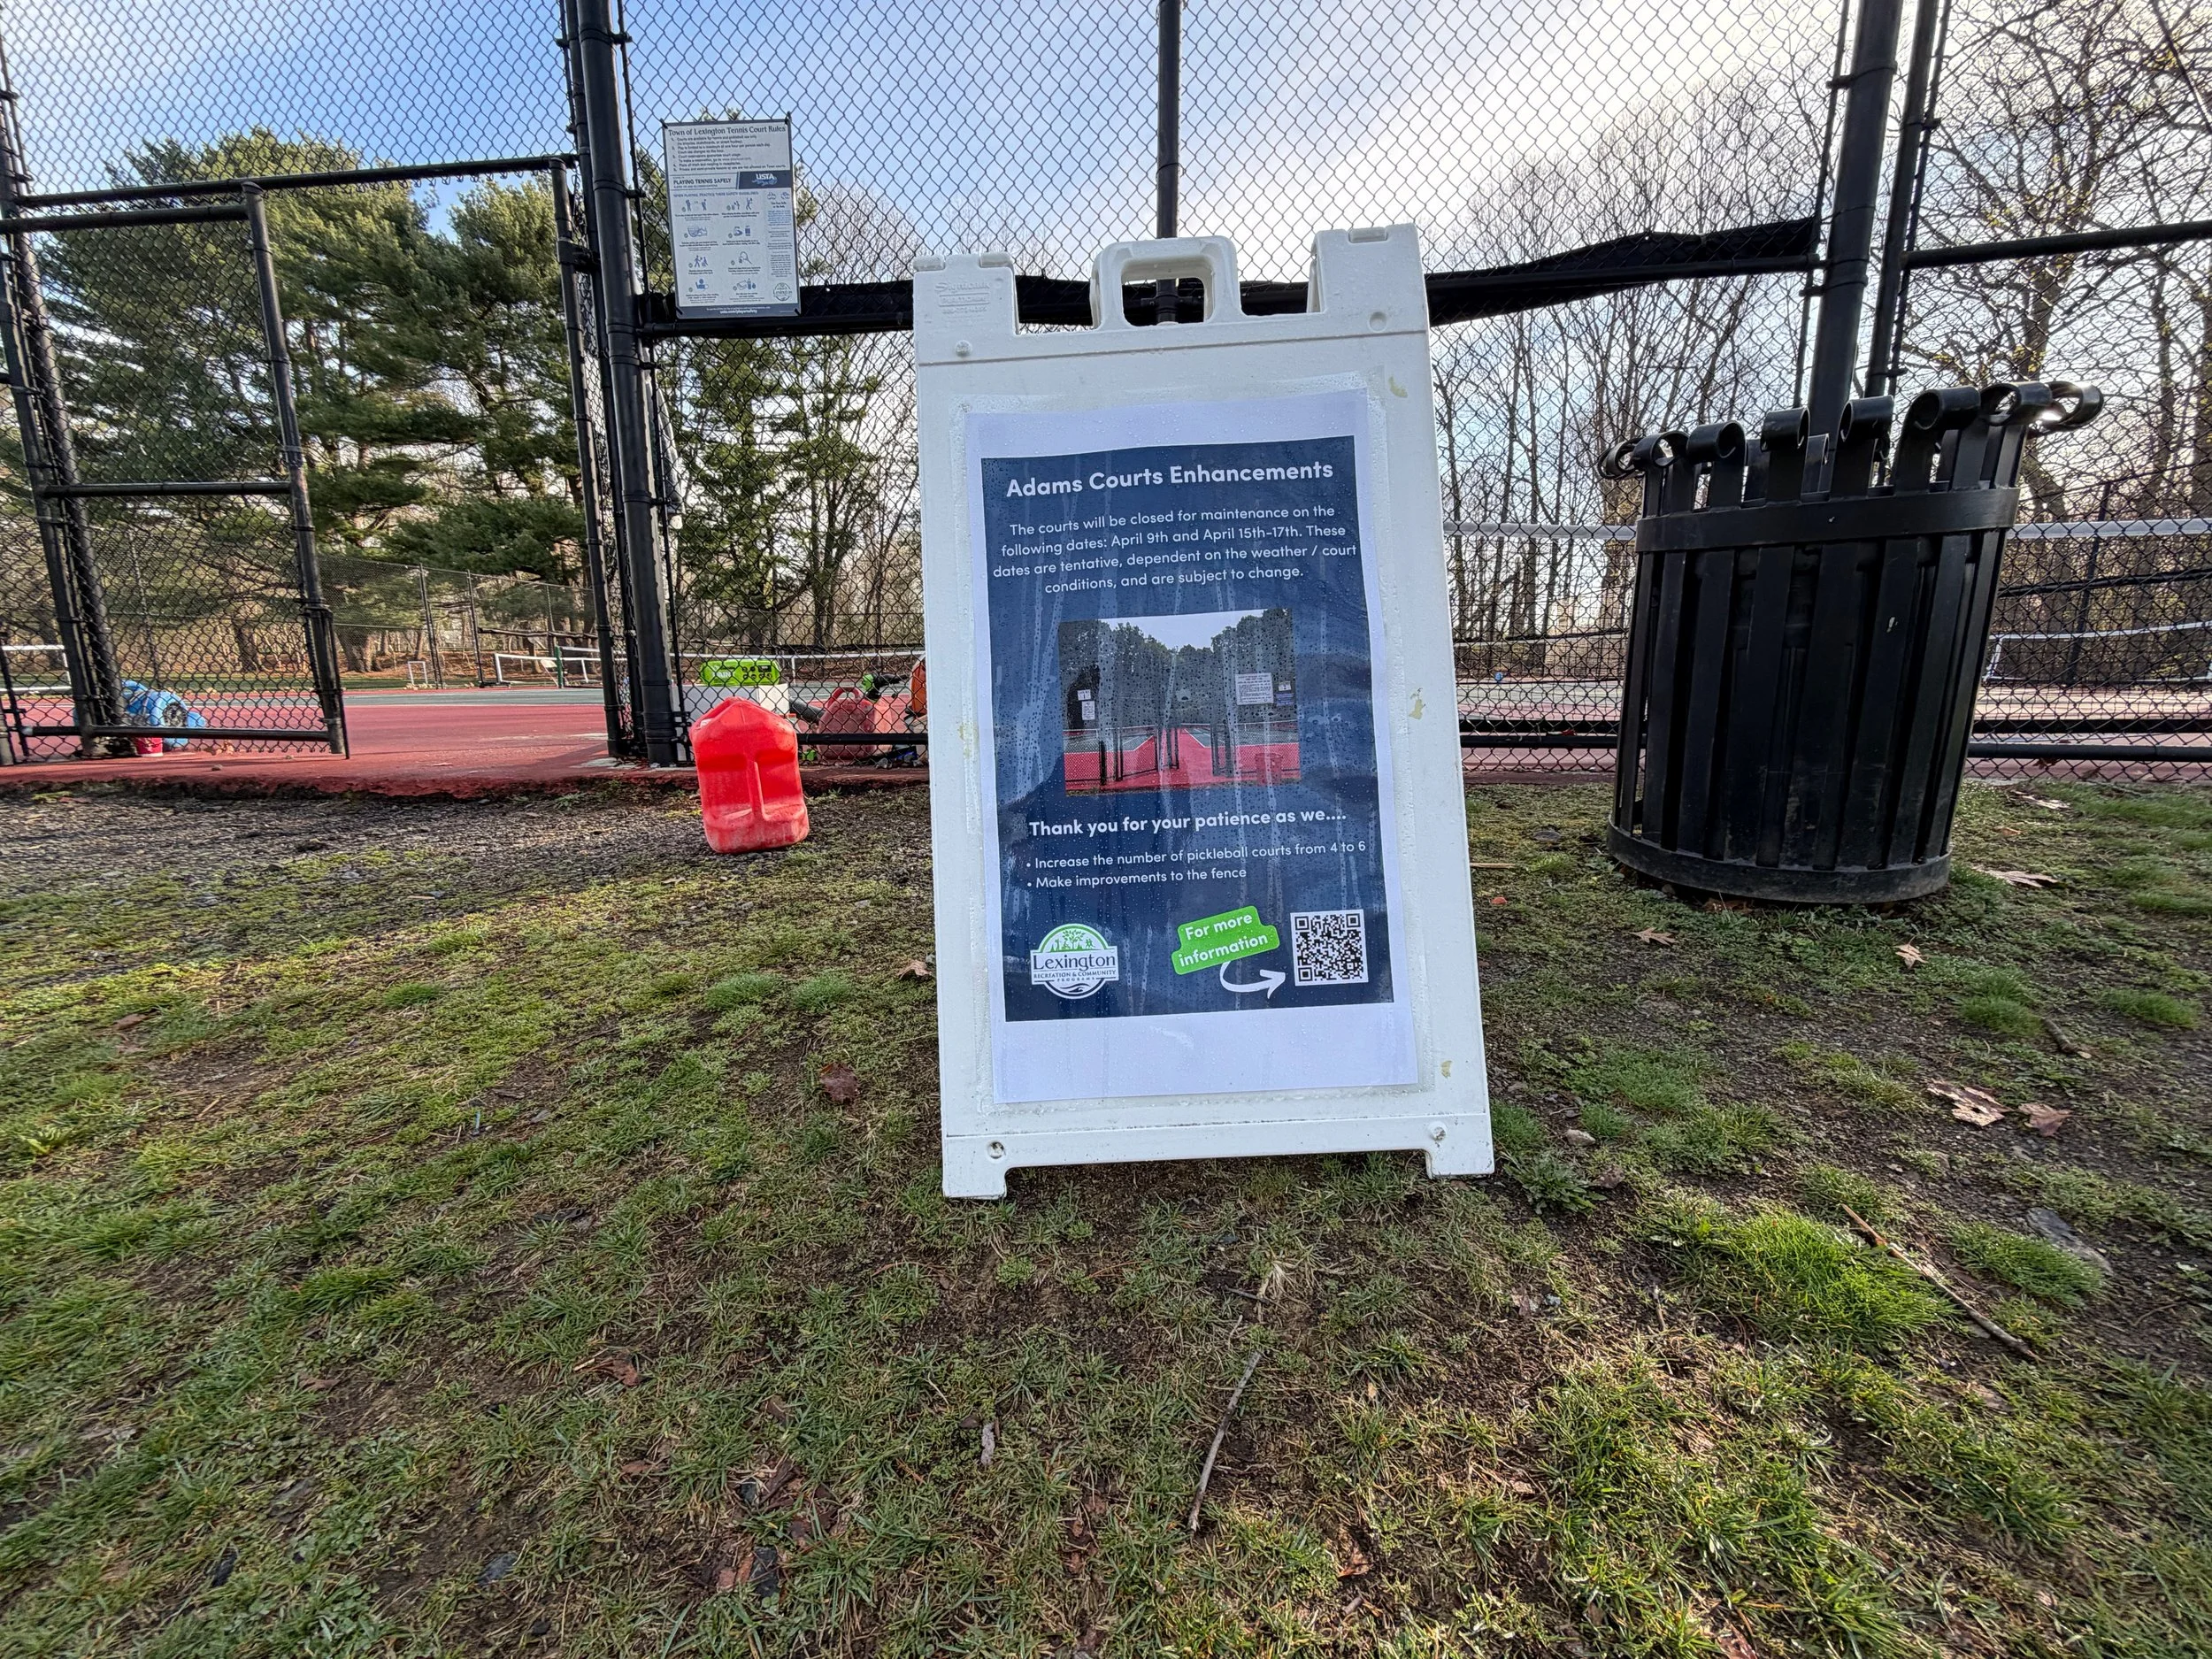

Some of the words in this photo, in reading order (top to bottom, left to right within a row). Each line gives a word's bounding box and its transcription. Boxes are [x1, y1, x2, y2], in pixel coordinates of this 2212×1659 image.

[694, 127, 726, 136] Lexington
[1007, 478, 1083, 497] Adams
[1088, 469, 1164, 490] Courts
[1170, 462, 1333, 483] Enhancements
[1010, 524, 1034, 535] The
[1039, 520, 1079, 534] courts
[1083, 516, 1105, 529] will
[1110, 515, 1126, 526] be
[1130, 511, 1173, 525] closed
[1178, 510, 1196, 521] for
[1202, 508, 1288, 520] maintenance
[1293, 508, 1310, 518] on
[1313, 505, 1334, 516] the
[1002, 542, 1062, 557] following
[1066, 539, 1107, 551] dates:
[1111, 533, 1142, 549] April
[1148, 531, 1168, 543] 9th
[1173, 529, 1199, 541] and
[1203, 528, 1234, 542] April
[1239, 526, 1302, 538] 15th-17th.
[1306, 525, 1346, 536] These
[993, 565, 1030, 577] dates
[1034, 564, 1056, 573] are
[1061, 557, 1123, 572] tentative,
[1127, 550, 1201, 567] dependent
[1205, 550, 1221, 561] on
[1225, 548, 1248, 559] the
[1251, 546, 1307, 558] weather
[1311, 545, 1318, 556] /
[1323, 545, 1356, 556] court
[1045, 579, 1117, 594] conditions,
[1121, 573, 1147, 587] and
[1152, 574, 1174, 584] are
[1179, 570, 1226, 585] subject
[1231, 569, 1244, 580] to
[1248, 566, 1303, 580] change.
[1029, 819, 1083, 836] Thank
[1088, 821, 1118, 837] you
[1123, 817, 1148, 831] for
[1152, 817, 1191, 833] your
[1195, 811, 1271, 832] patience
[1276, 811, 1296, 823] as
[1301, 810, 1347, 822] we....
[1035, 857, 1089, 869] Increase
[1093, 855, 1113, 865] the
[1118, 852, 1166, 864] number
[1171, 850, 1183, 861] of
[1187, 847, 1248, 864] pickleball
[1252, 846, 1292, 856] courts
[1295, 843, 1325, 855] from
[1330, 842, 1337, 853] 4
[1342, 842, 1355, 852] to
[1358, 841, 1366, 851] 6
[1036, 876, 1072, 888] Make
[1076, 872, 1166, 888] improvements
[1171, 871, 1183, 881] to
[1187, 869, 1207, 880] the
[1211, 867, 1247, 879] fence
[1185, 925, 1210, 940] For
[1213, 915, 1252, 933] more
[1033, 954, 1116, 971] Lexington
[1179, 934, 1268, 966] information
